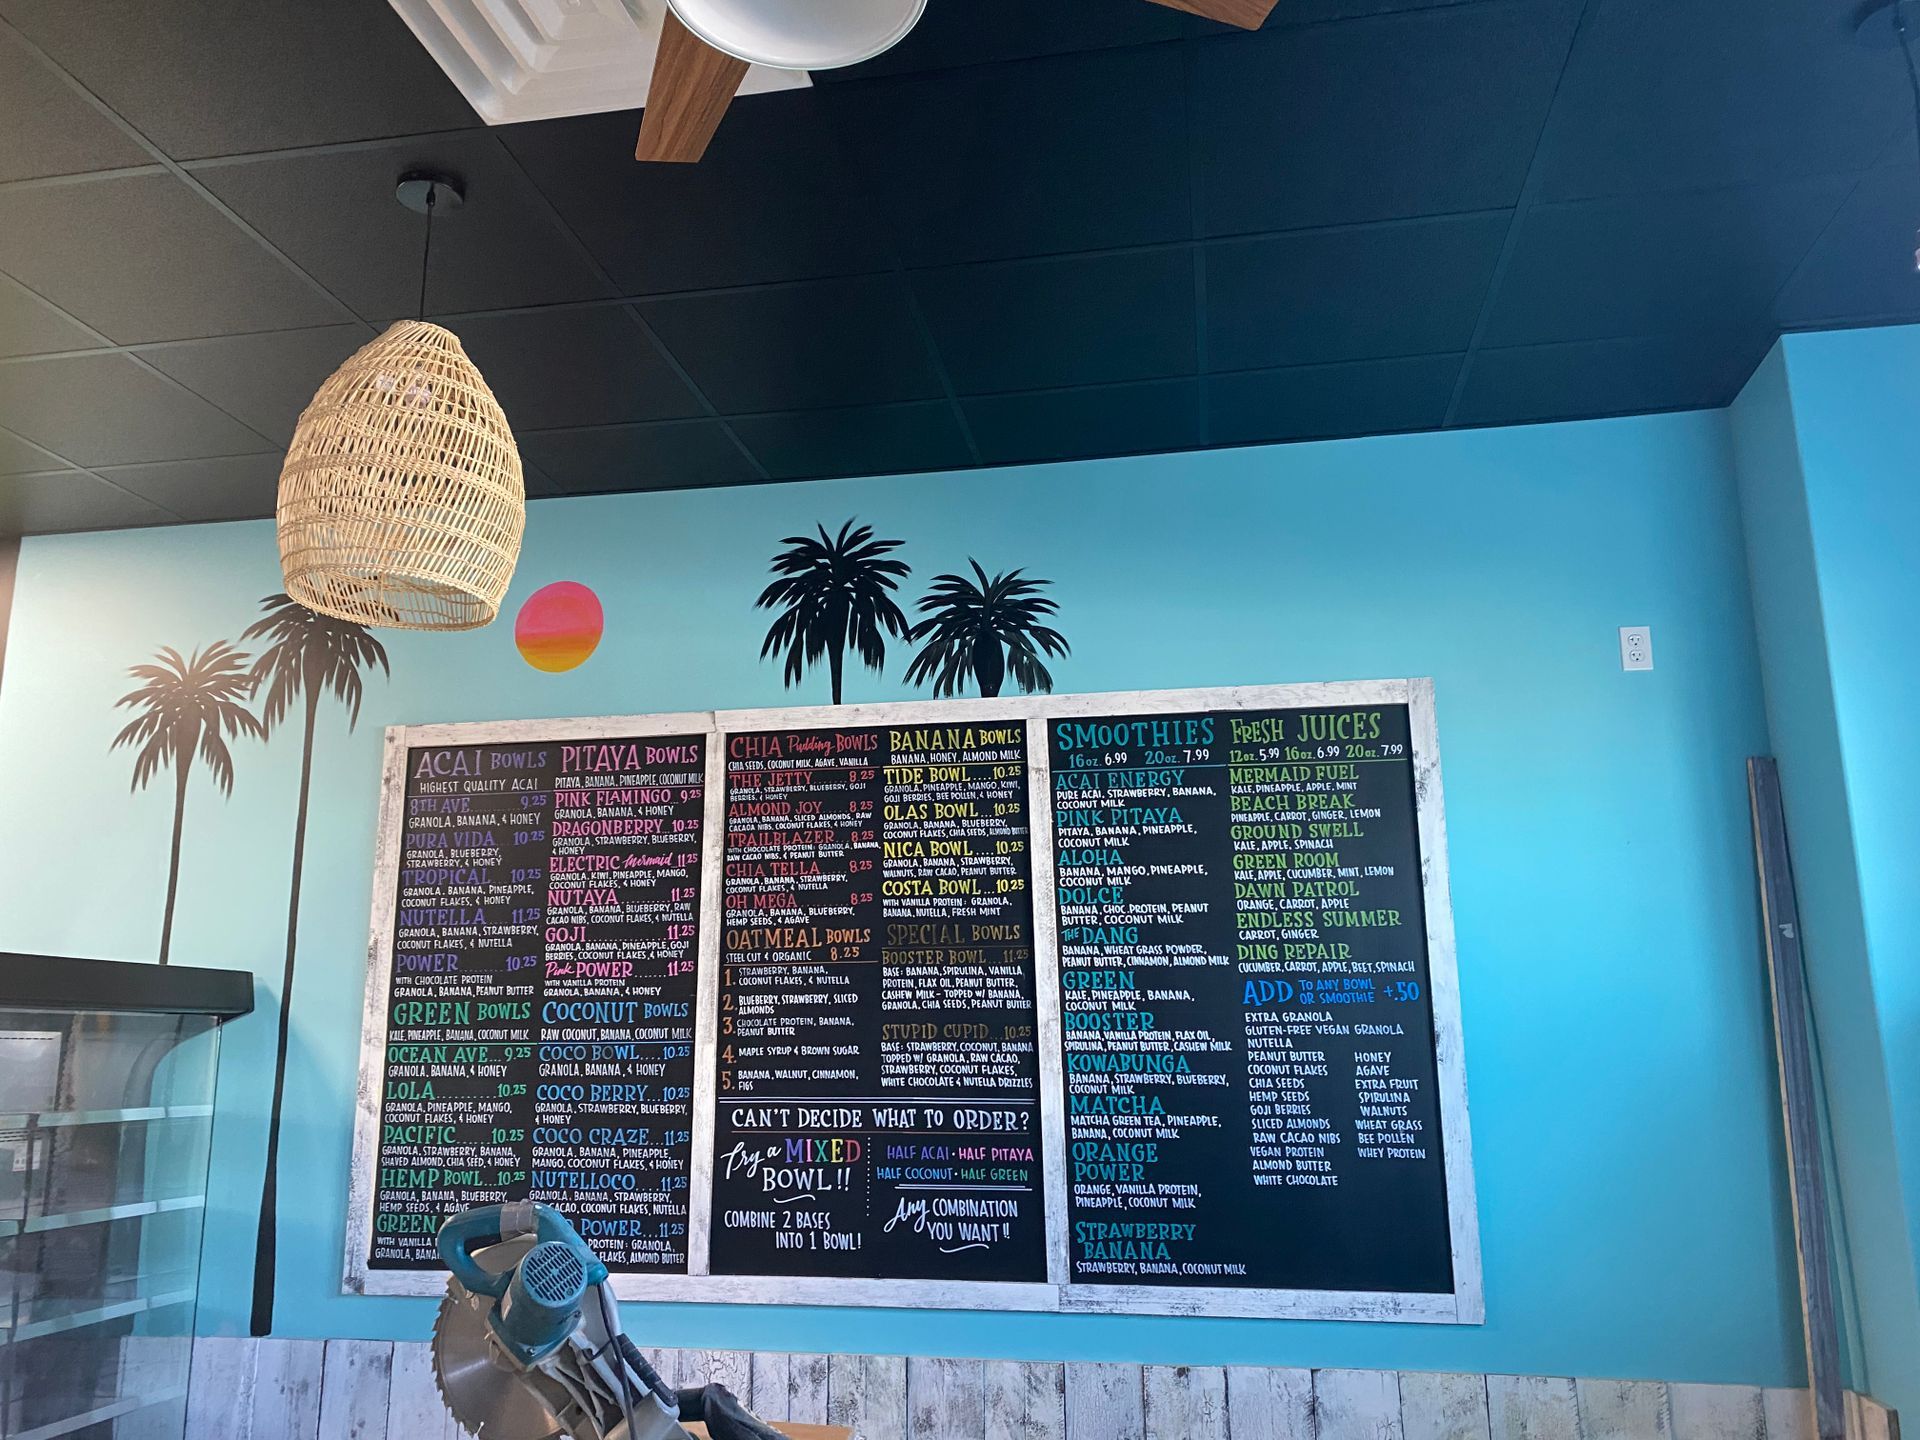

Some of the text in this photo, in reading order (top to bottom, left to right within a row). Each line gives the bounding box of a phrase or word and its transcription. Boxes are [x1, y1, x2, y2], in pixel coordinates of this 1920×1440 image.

[1056, 718, 1215, 750] SMOOTHIES
[1230, 712, 1381, 745] FRESH JUICES
[730, 736, 783, 758] CHIA
[836, 734, 878, 751] BOWLS
[889, 729, 1021, 752] BANANA BOWLS
[561, 745, 698, 773] PITAYA BOWLS
[962, 751, 997, 762] ALMOND
[1000, 750, 1020, 760] MILK
[1105, 752, 1127, 766] 6.99
[1183, 749, 1209, 764] 7.99
[1259, 749, 1279, 762] 5.99
[1317, 747, 1340, 759] 6.99
[1381, 744, 1403, 756] 7.99
[414, 750, 547, 778] ACAI BOWLS
[884, 766, 1021, 785] TIDE BOWL 10.25
[1230, 765, 1359, 784] MERMAID FUEL
[420, 778, 538, 793] HIGHEST QUALITY ACAI
[555, 789, 671, 808] PINK FLAMINGO
[1057, 799, 1125, 809] COCONUT MILK
[552, 820, 698, 836] DRAGONBERRY 10.25
[1058, 849, 1124, 866] ALOHA
[402, 868, 491, 886] TROPICAL
[883, 879, 1024, 896] COSTA BOWL 10.25
[401, 908, 486, 926] NUTELLA
[1237, 910, 1401, 928] ENDLESS SUMMER
[546, 925, 695, 942] GOJI 11.25
[726, 929, 870, 950] OATMEAL BOWLS
[888, 924, 1020, 946] SPECIAL BOWLS
[1062, 927, 1138, 945] THE DANG
[415, 975, 458, 984] CHOCOLATE
[462, 974, 492, 984] PROTEIN
[576, 962, 633, 978] POWER
[1243, 980, 1293, 1006] ADD
[1316, 980, 1339, 991] ANY
[1343, 978, 1376, 990] BOWL
[1300, 991, 1375, 1005] OR SMOOTHIE
[394, 1001, 530, 1026] GREEN BOWLS
[542, 1002, 688, 1024] COCONUT BOWLS
[1245, 1011, 1332, 1023] EXTRA GRANOLA
[1245, 1025, 1403, 1035] GLUTEN-FREE VEGAN GRANOLA
[739, 1047, 764, 1056] MAPLE
[767, 1046, 792, 1056] SYRUP
[802, 1046, 830, 1055] BROWN
[832, 1045, 859, 1055] SUGAR
[1247, 1038, 1293, 1049] NUTELLA
[389, 1047, 531, 1063] OCEAN AVE 9.25
[1067, 1054, 1190, 1073] KOWABUNGA
[1248, 1051, 1324, 1062] PEANUT BUTTER
[1355, 1052, 1391, 1062] HONEY
[1247, 1064, 1327, 1076] COCONUT FLAKES
[1356, 1065, 1389, 1076] AGAVE
[387, 1081, 526, 1099] LOLA 10.25
[881, 1077, 905, 1087] WHITE
[908, 1077, 954, 1087] CHOCOLATE
[964, 1077, 996, 1087] NUTELLA
[998, 1077, 1032, 1088] DRIZZLES
[1249, 1078, 1305, 1089] CHIA SEEDS
[1070, 1097, 1165, 1115] MATCHA
[1359, 1092, 1410, 1103] SPIRULINA
[732, 1108, 1029, 1131] CAN'T DECIDE WHAT TO ORDER?
[1360, 1106, 1407, 1116] WALNUTS
[384, 1125, 524, 1144] PACIFIC 10.25
[532, 1128, 689, 1146] COCO CRAZE 11.25
[1358, 1133, 1414, 1144] BEE POLLEN
[720, 1138, 861, 1179] Try a MIXED
[1072, 1143, 1158, 1163] ORANGE
[1358, 1147, 1426, 1159] WHEY PROTEIN
[531, 1171, 687, 1191] NUTELLOCO 11.25
[877, 1167, 1028, 1181] HALF COCONUT HALF GREEN
[725, 1211, 830, 1229] COMBINE 2 BASES
[883, 1196, 1017, 1233] Any COMBINATION
[927, 1221, 953, 1239] YOU
[1076, 1222, 1196, 1243] STRAWBERRY
[776, 1232, 861, 1250] INTO 1 BOWL!
[1084, 1242, 1171, 1260] BANANA
[1183, 1263, 1221, 1275] COCONUT
[1223, 1264, 1246, 1275] MILK
